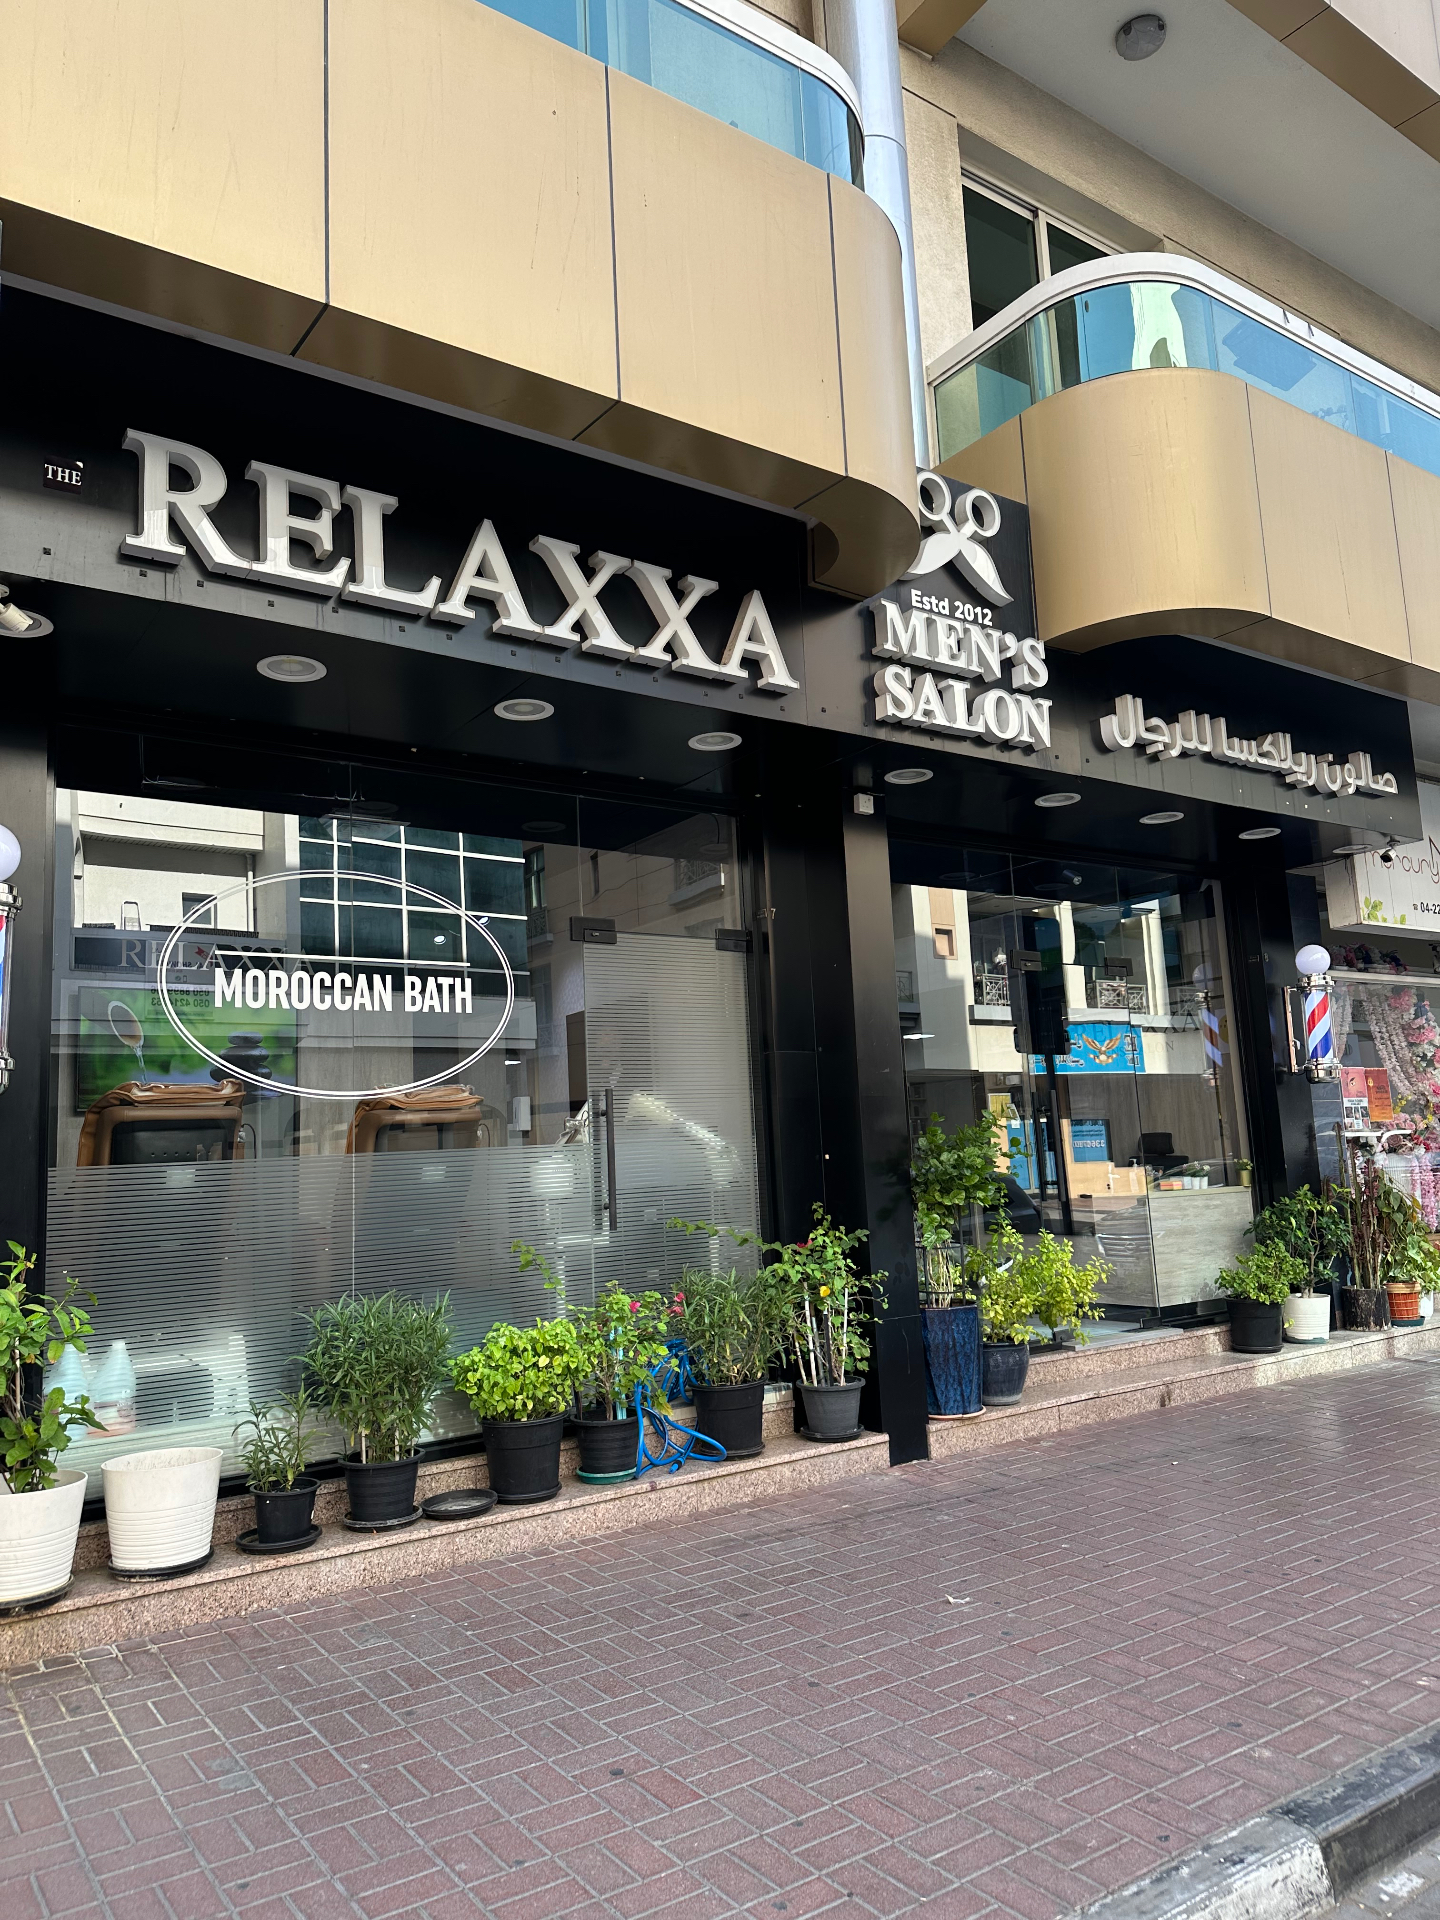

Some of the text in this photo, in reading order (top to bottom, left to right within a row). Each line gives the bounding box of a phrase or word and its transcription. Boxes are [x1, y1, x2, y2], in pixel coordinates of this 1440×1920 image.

[44, 463, 82, 486] THE
[122, 427, 800, 696] RELAXXA
[911, 590, 993, 627] Estd 2012
[870, 598, 1049, 692] MEN'S
[874, 664, 1053, 751] SALON
[1100, 694, 1213, 761] للرجال
[1316, 751, 1398, 798] صالون
[214, 967, 473, 1014] MOROCCAN BATH
